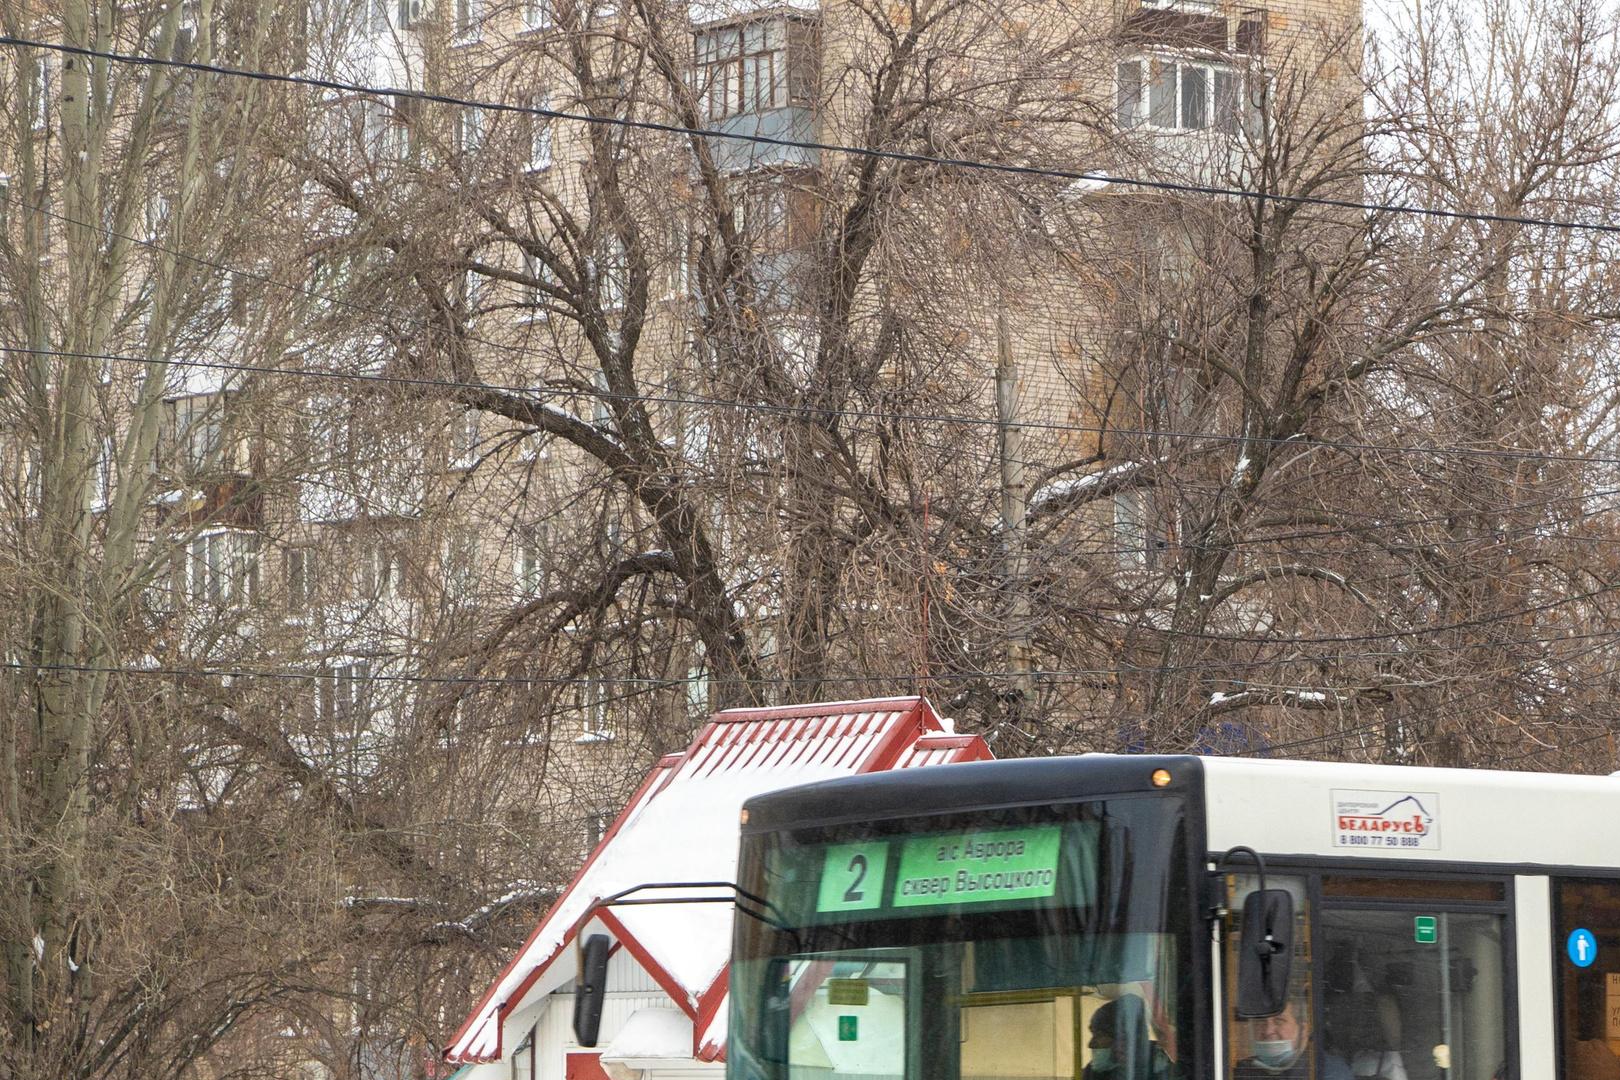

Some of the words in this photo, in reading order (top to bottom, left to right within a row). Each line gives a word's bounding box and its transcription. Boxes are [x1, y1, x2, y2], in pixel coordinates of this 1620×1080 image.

[964, 839, 1026, 863] Аврора
[1349, 835, 1368, 845] 800
[1370, 836, 1383, 845] 77
[1385, 836, 1399, 846] 50
[843, 854, 869, 902] 2
[902, 876, 950, 898] сквер
[955, 868, 1053, 893] Высоцкого
